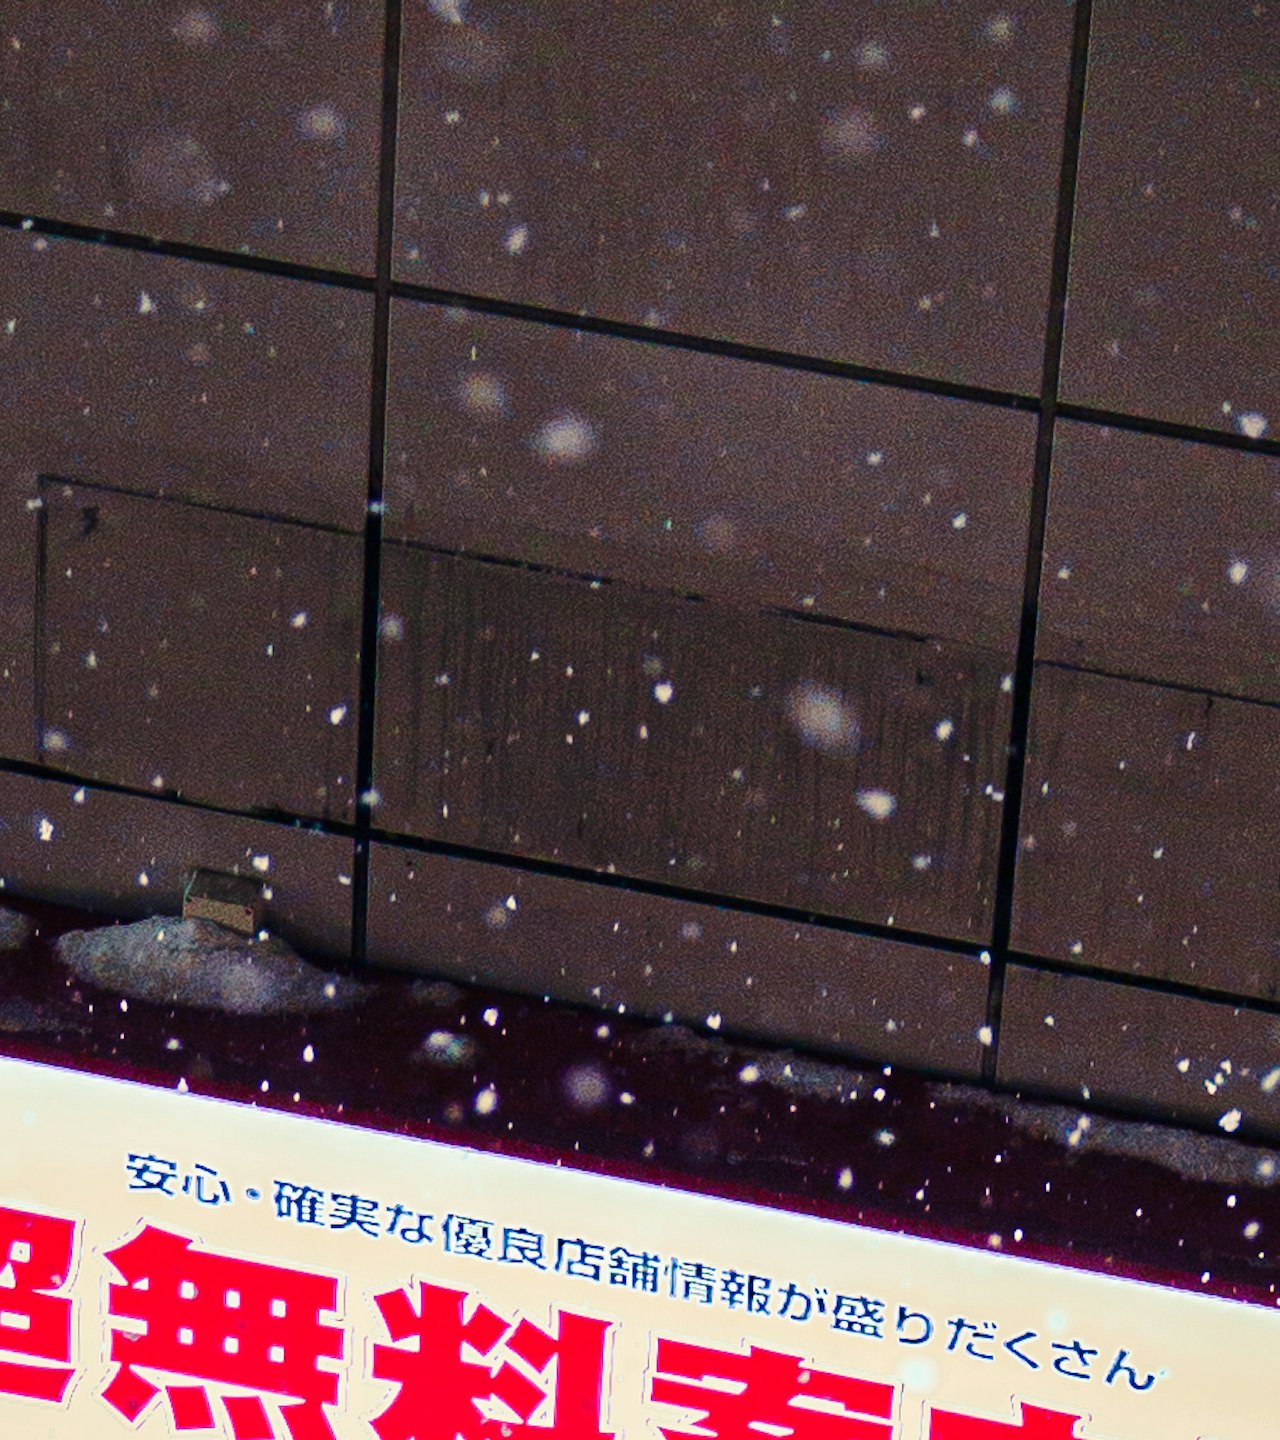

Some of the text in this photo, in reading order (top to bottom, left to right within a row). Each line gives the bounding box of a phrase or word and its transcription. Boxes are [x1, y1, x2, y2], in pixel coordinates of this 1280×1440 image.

[126, 1153, 1155, 1391] 安心・確実な優良店舗情報が盛りだくさん
